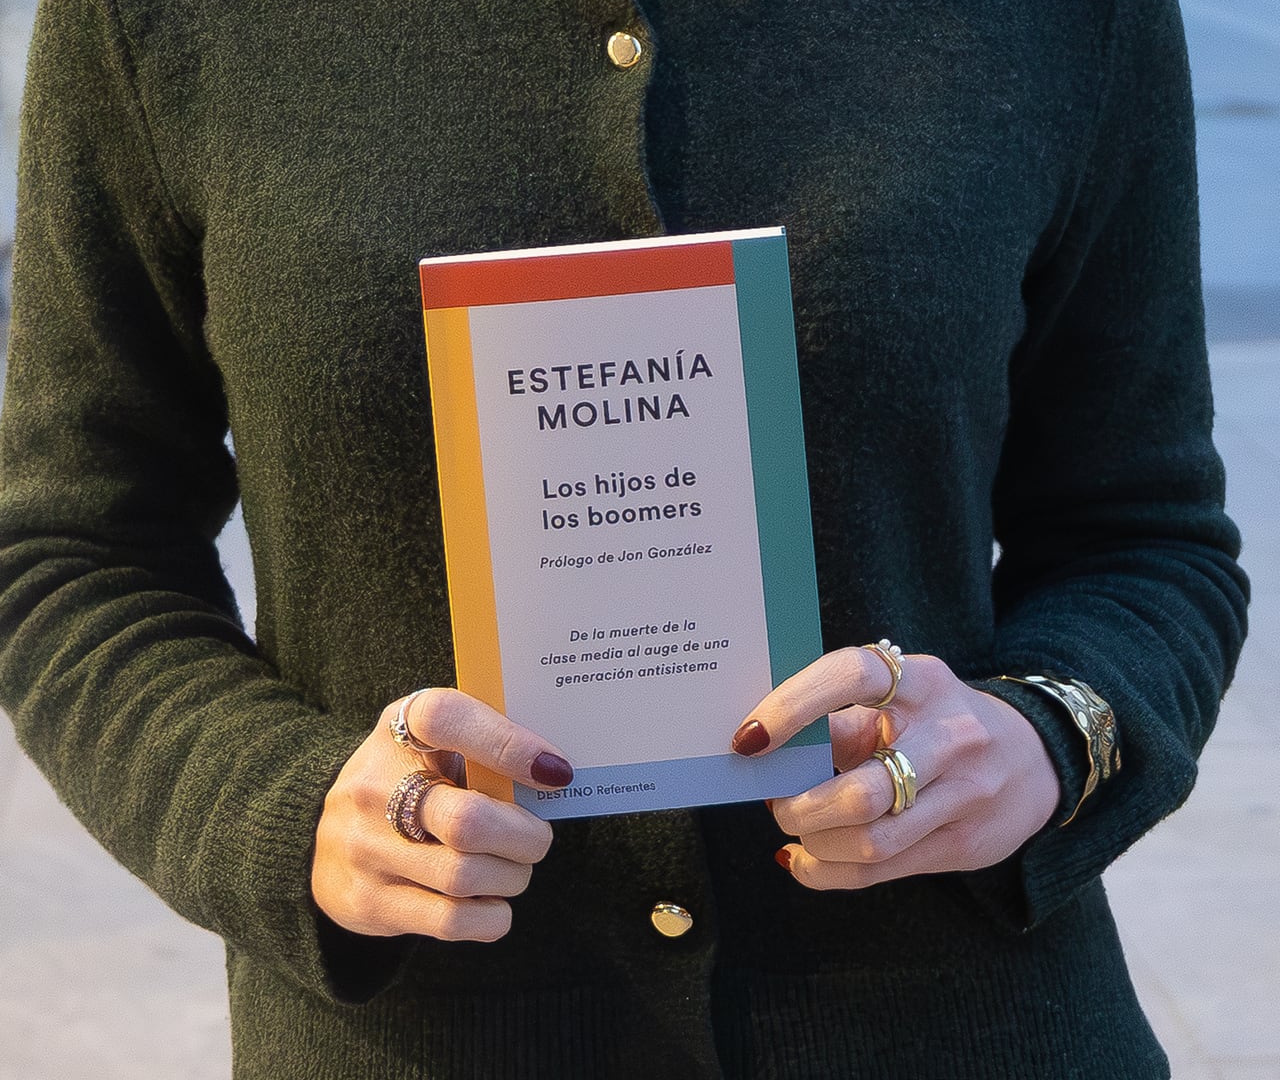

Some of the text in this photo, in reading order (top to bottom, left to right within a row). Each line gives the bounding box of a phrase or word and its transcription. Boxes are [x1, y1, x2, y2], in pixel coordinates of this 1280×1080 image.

[507, 349, 713, 395] ESTEFANÍA
[537, 393, 690, 430] MOLINA
[542, 466, 697, 499] Los hijos de
[542, 501, 702, 530] los boomers
[540, 543, 712, 568] Prólogo de Jon González
[570, 619, 696, 642] De la muerte de la
[540, 639, 729, 666] clase media al auge de una
[555, 660, 718, 688] generación antisistema
[536, 781, 656, 800] DESTINO Referentes
